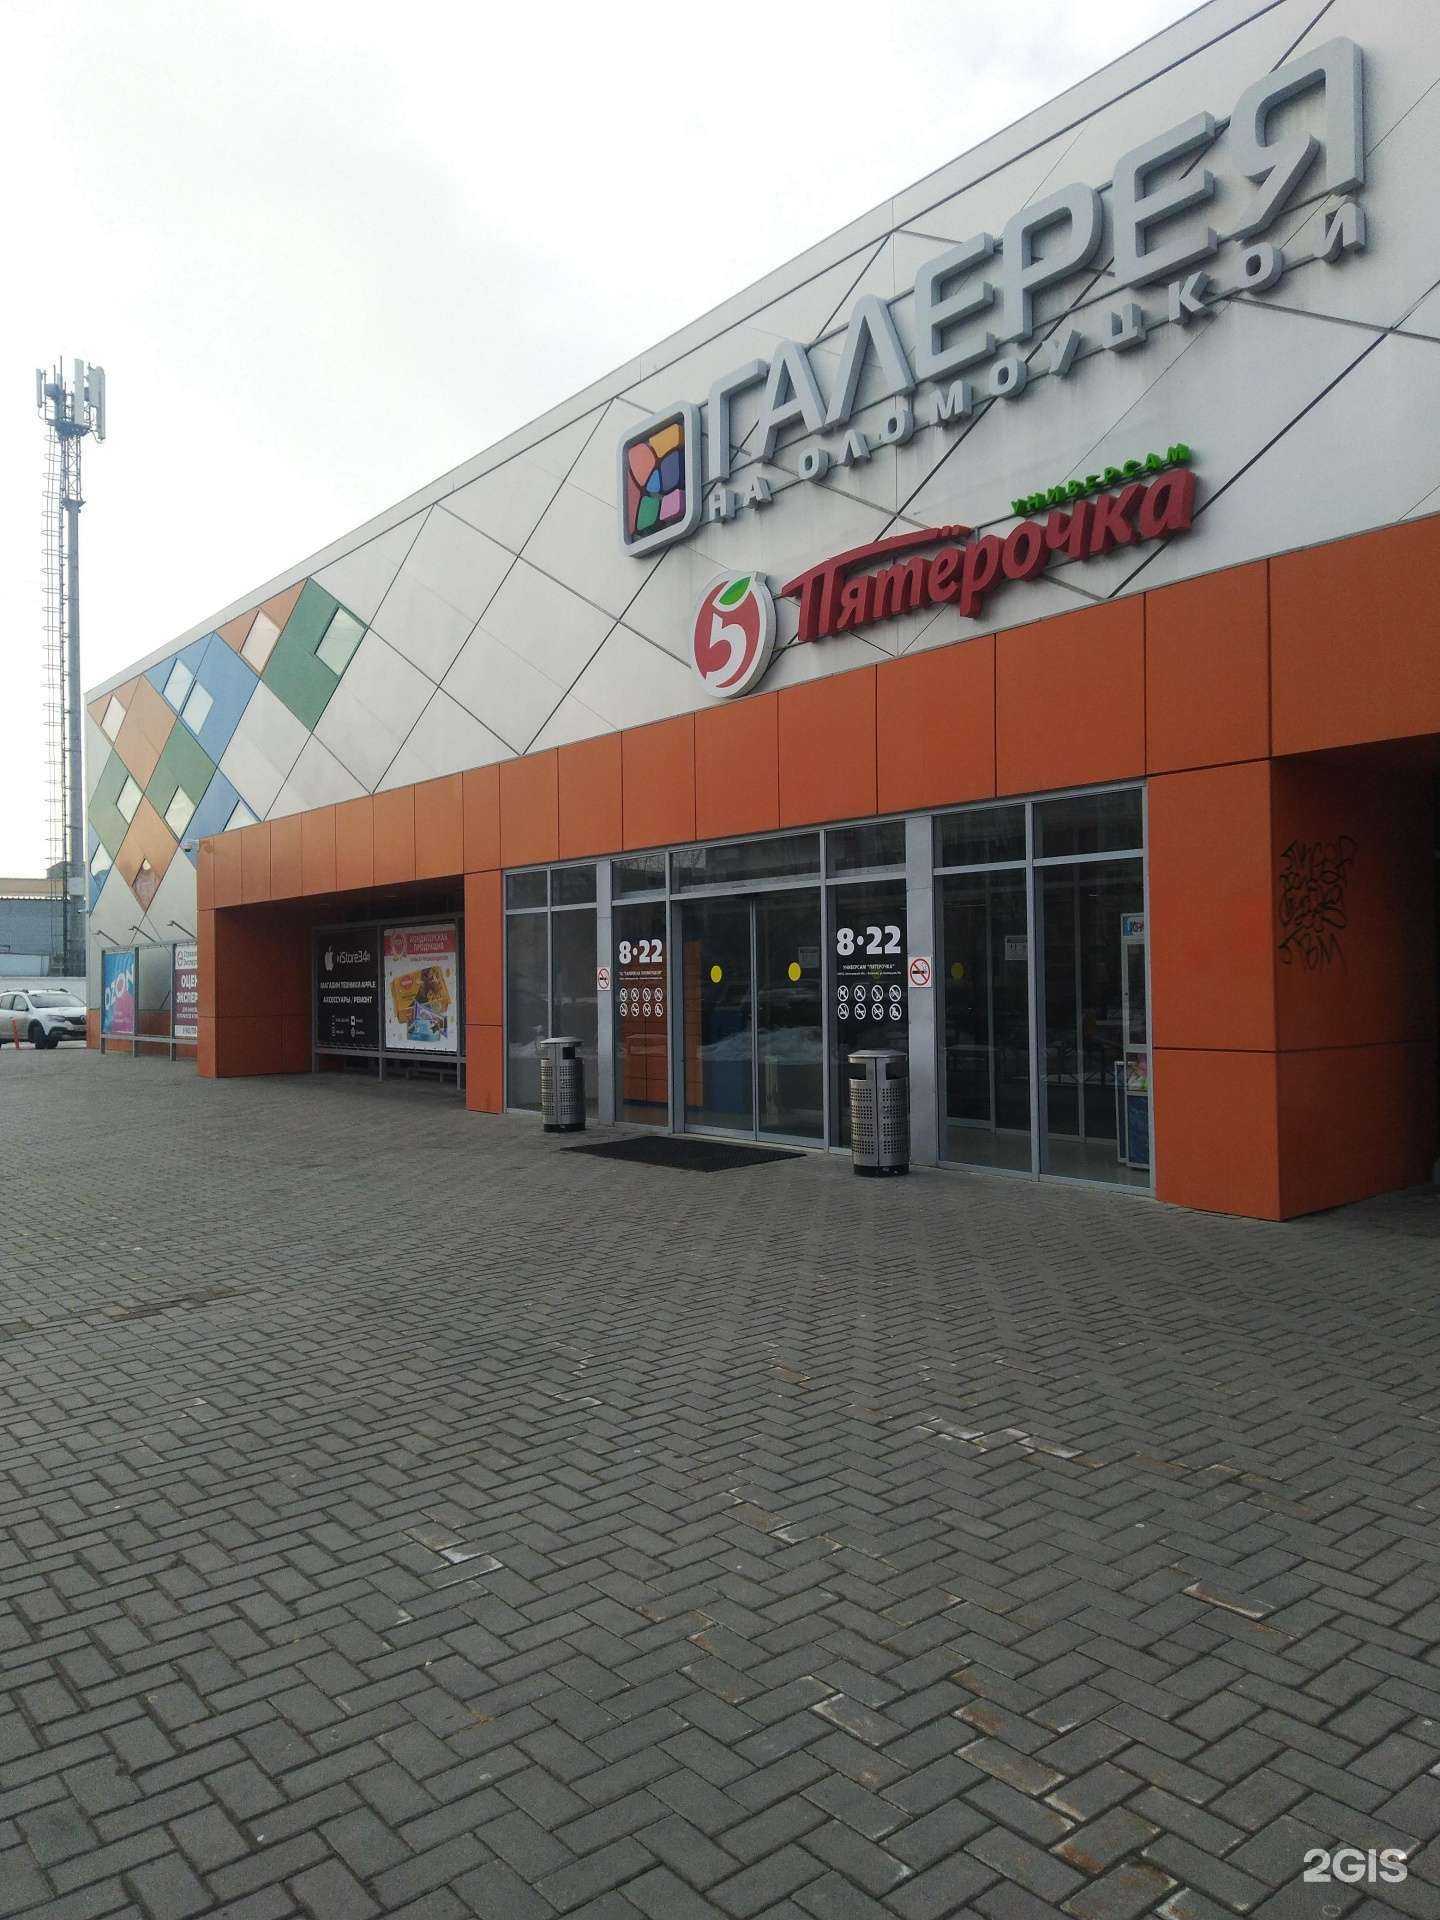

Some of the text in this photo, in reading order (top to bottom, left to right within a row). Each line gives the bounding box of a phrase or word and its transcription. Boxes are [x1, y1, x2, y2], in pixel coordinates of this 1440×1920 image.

[708, 36, 1364, 482] ГАЛЕРЕЯ
[709, 195, 1366, 524] НА ОЛОМОУЦКОЙ
[1010, 443, 1192, 517] УНИВЕРСАМ
[104, 963, 134, 1010] OZON
